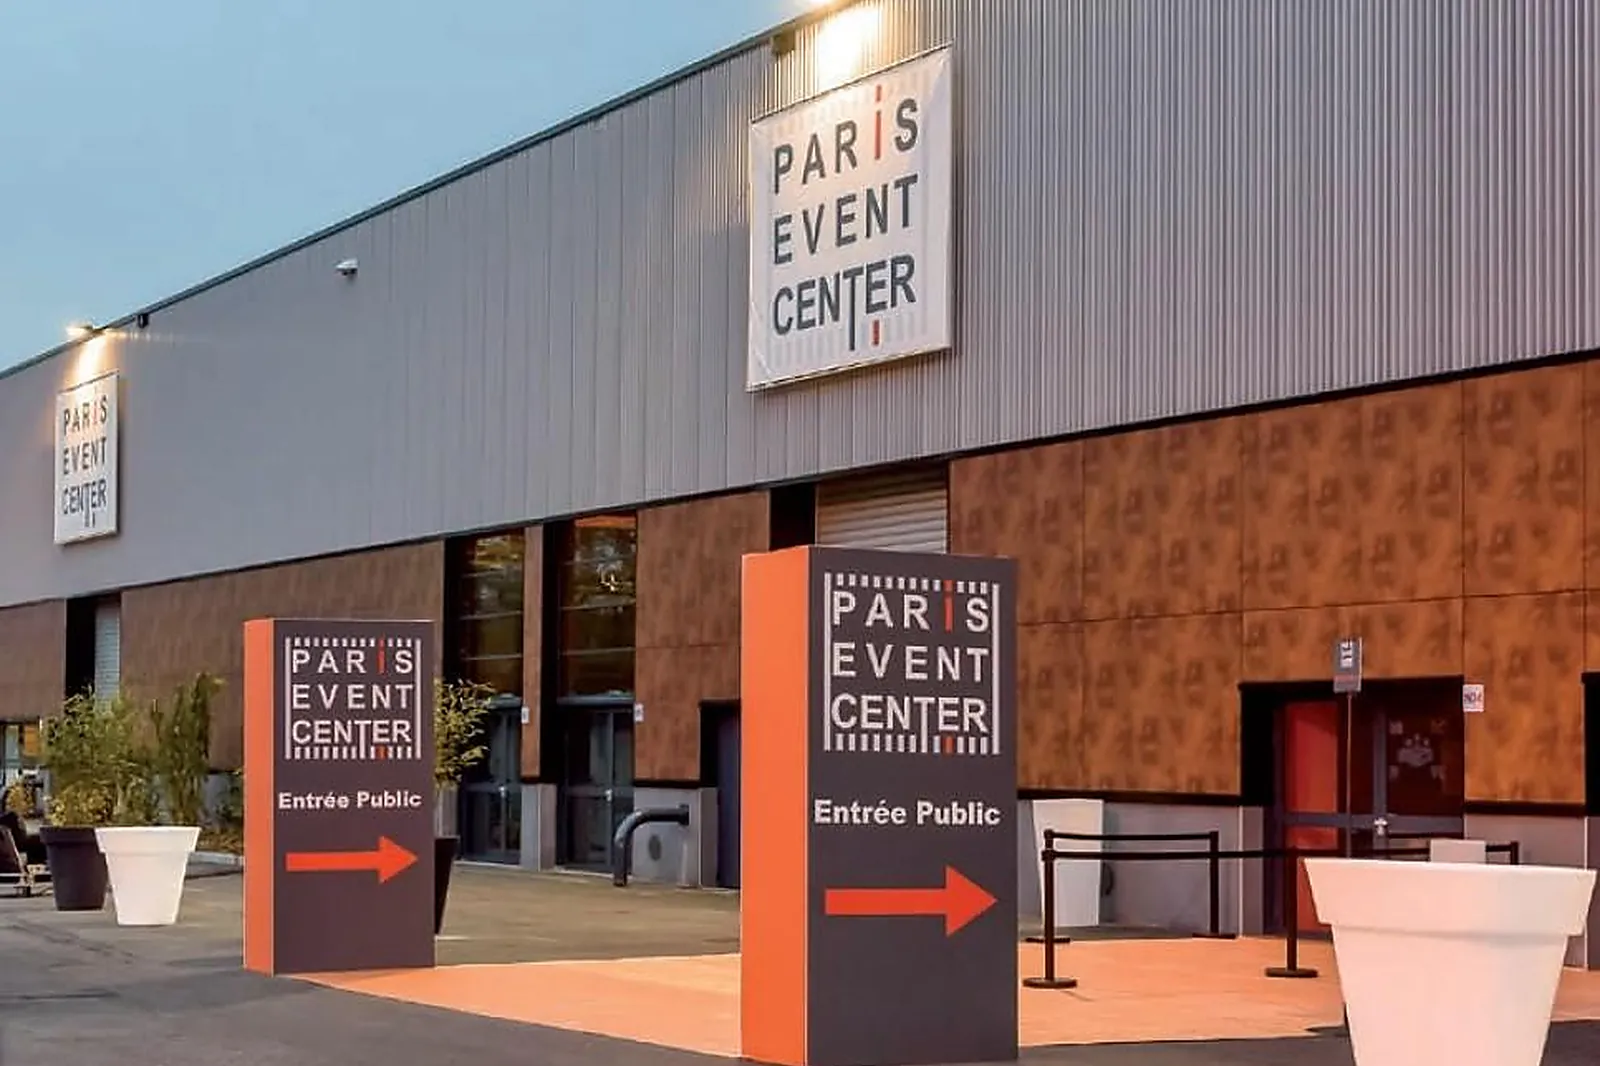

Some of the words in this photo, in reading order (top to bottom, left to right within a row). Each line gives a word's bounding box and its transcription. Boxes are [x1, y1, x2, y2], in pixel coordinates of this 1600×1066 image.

[773, 174, 919, 265] EVENT
[773, 254, 917, 351] CENTER
[63, 437, 107, 475] EVENT
[62, 478, 107, 527] CENTER
[832, 642, 990, 682] EVENT
[292, 684, 414, 709] EVENT
[292, 719, 413, 759] CENTER
[831, 693, 989, 753] CENTER
[278, 791, 349, 810] Entrée
[357, 790, 422, 809] Public
[813, 799, 906, 826] Entrée
[916, 800, 1000, 826] Public
